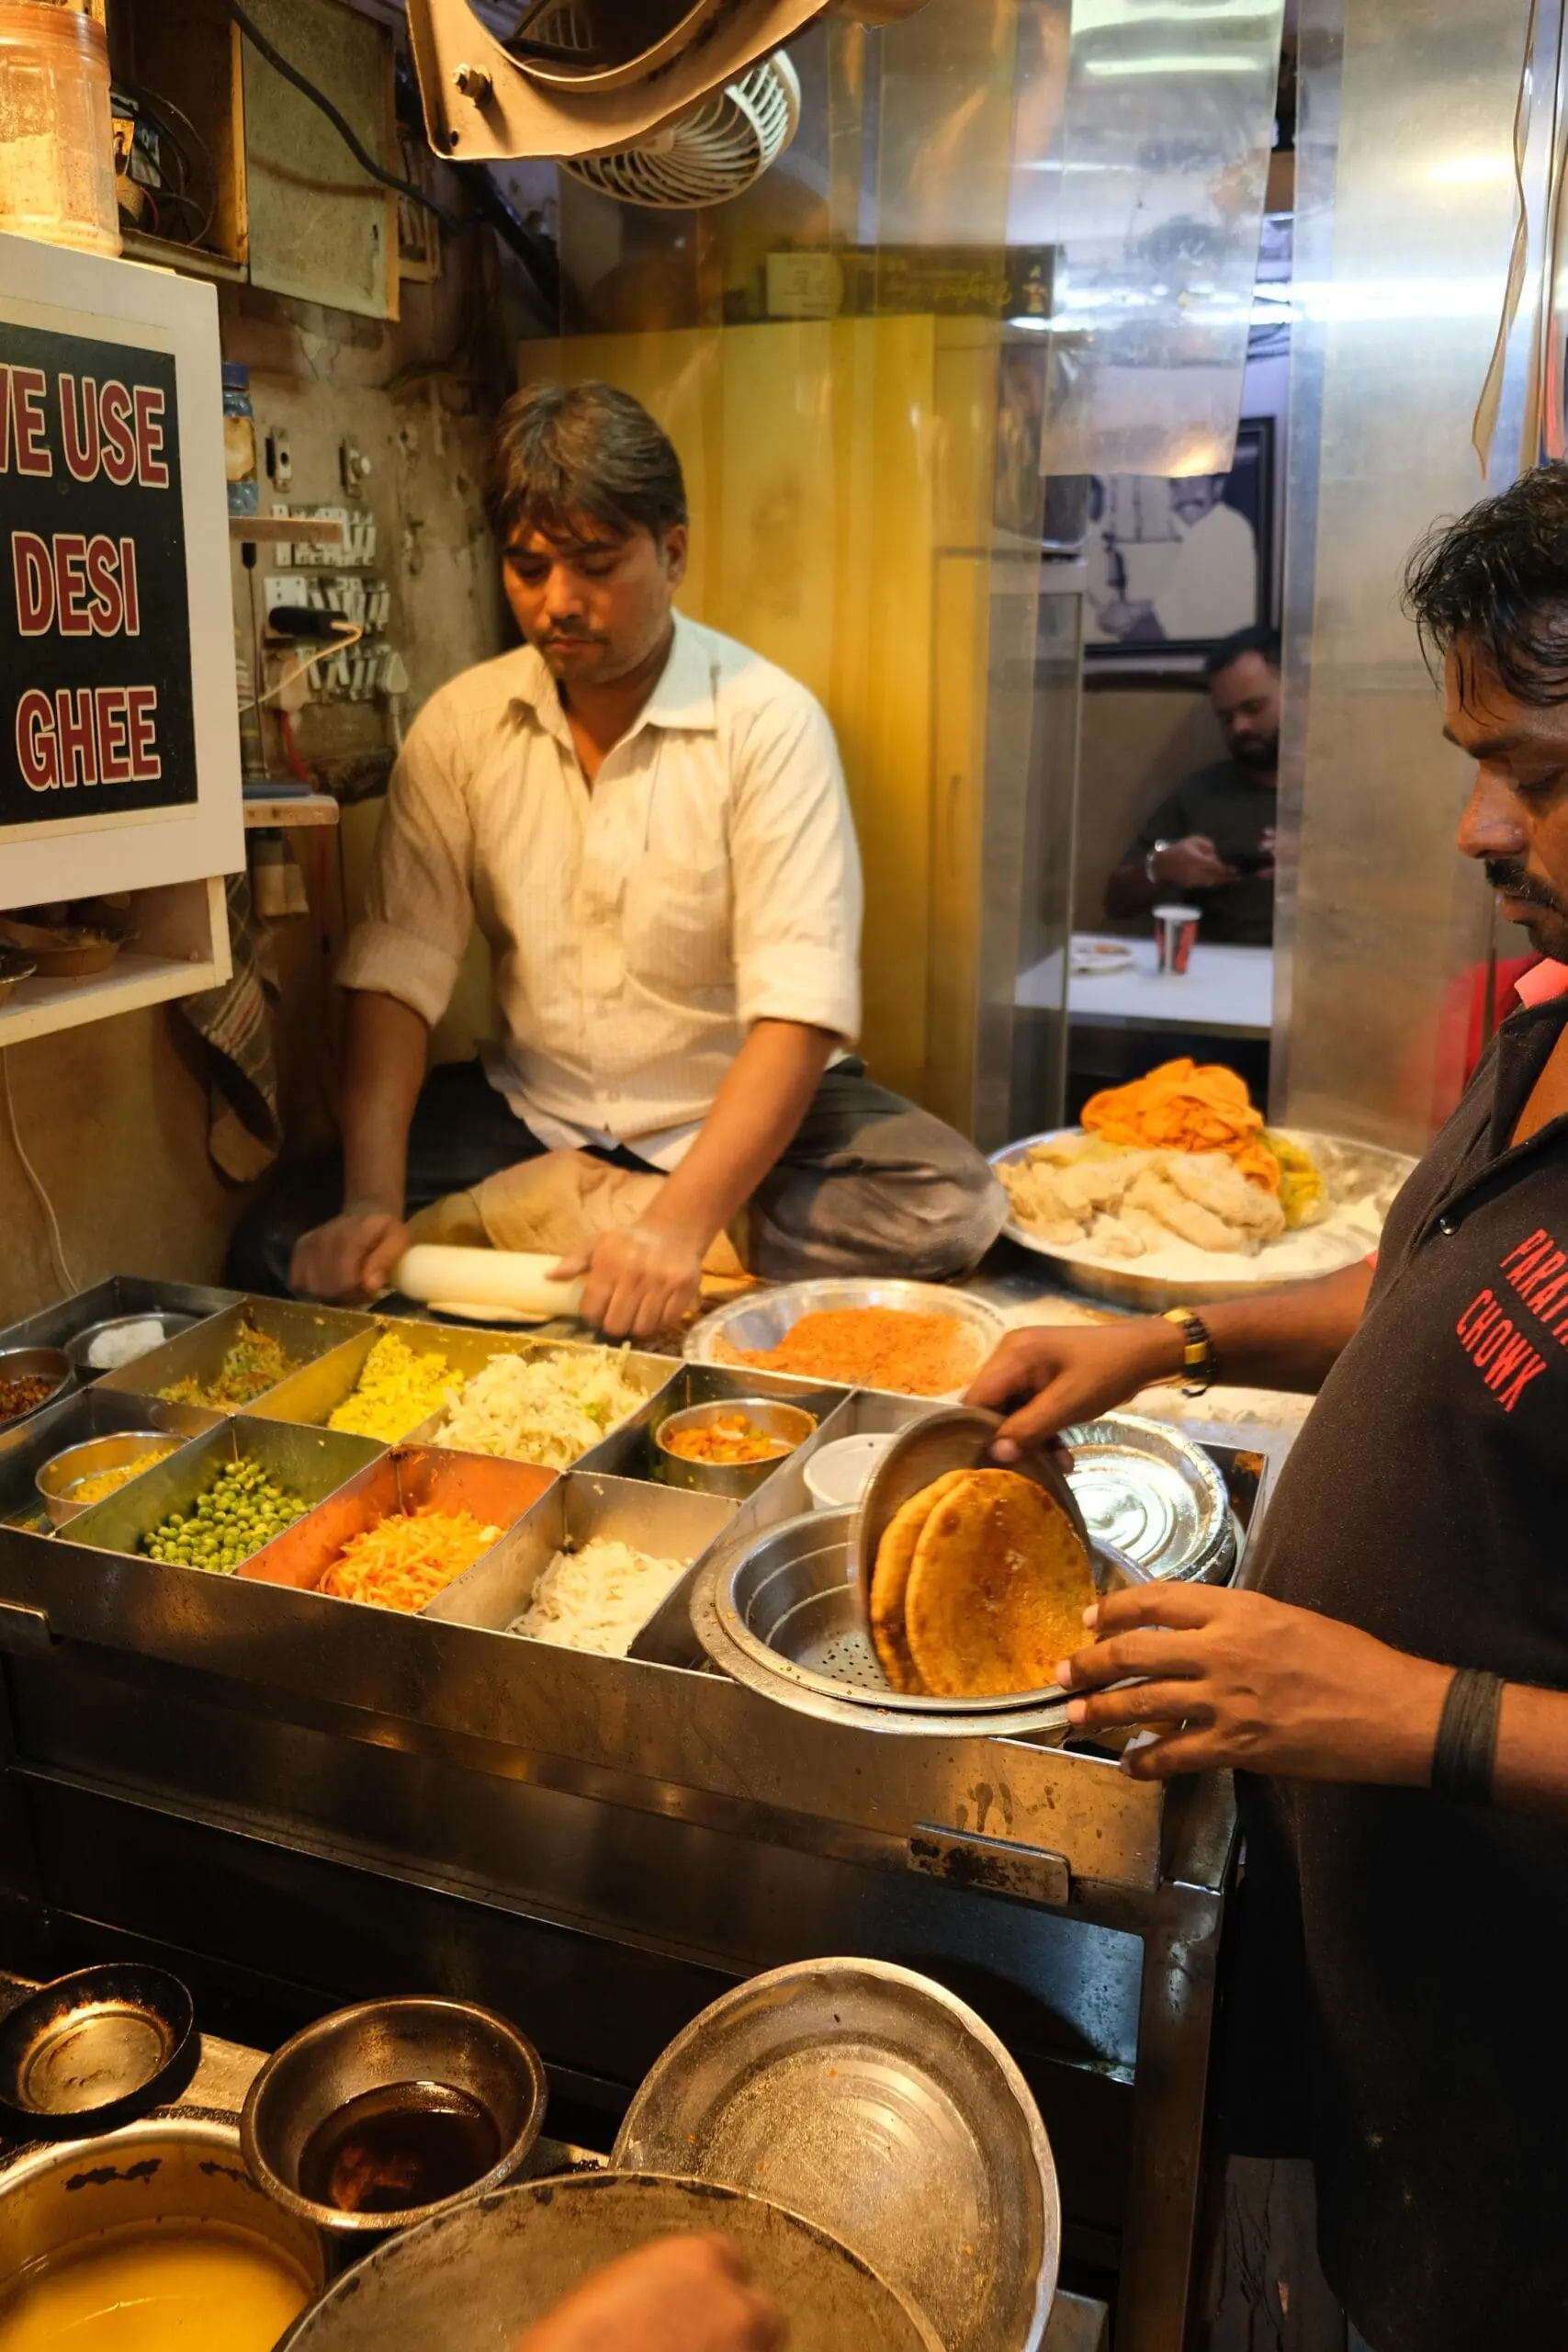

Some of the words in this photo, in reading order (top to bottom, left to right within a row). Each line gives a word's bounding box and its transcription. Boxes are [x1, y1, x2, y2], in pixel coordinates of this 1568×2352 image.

[59, 372, 170, 489] USE
[11, 531, 141, 638] DESI
[16, 685, 162, 792] GHEE
[1499, 1227, 1568, 1348] PARA
[1456, 1288, 1548, 1413] CHOWK
